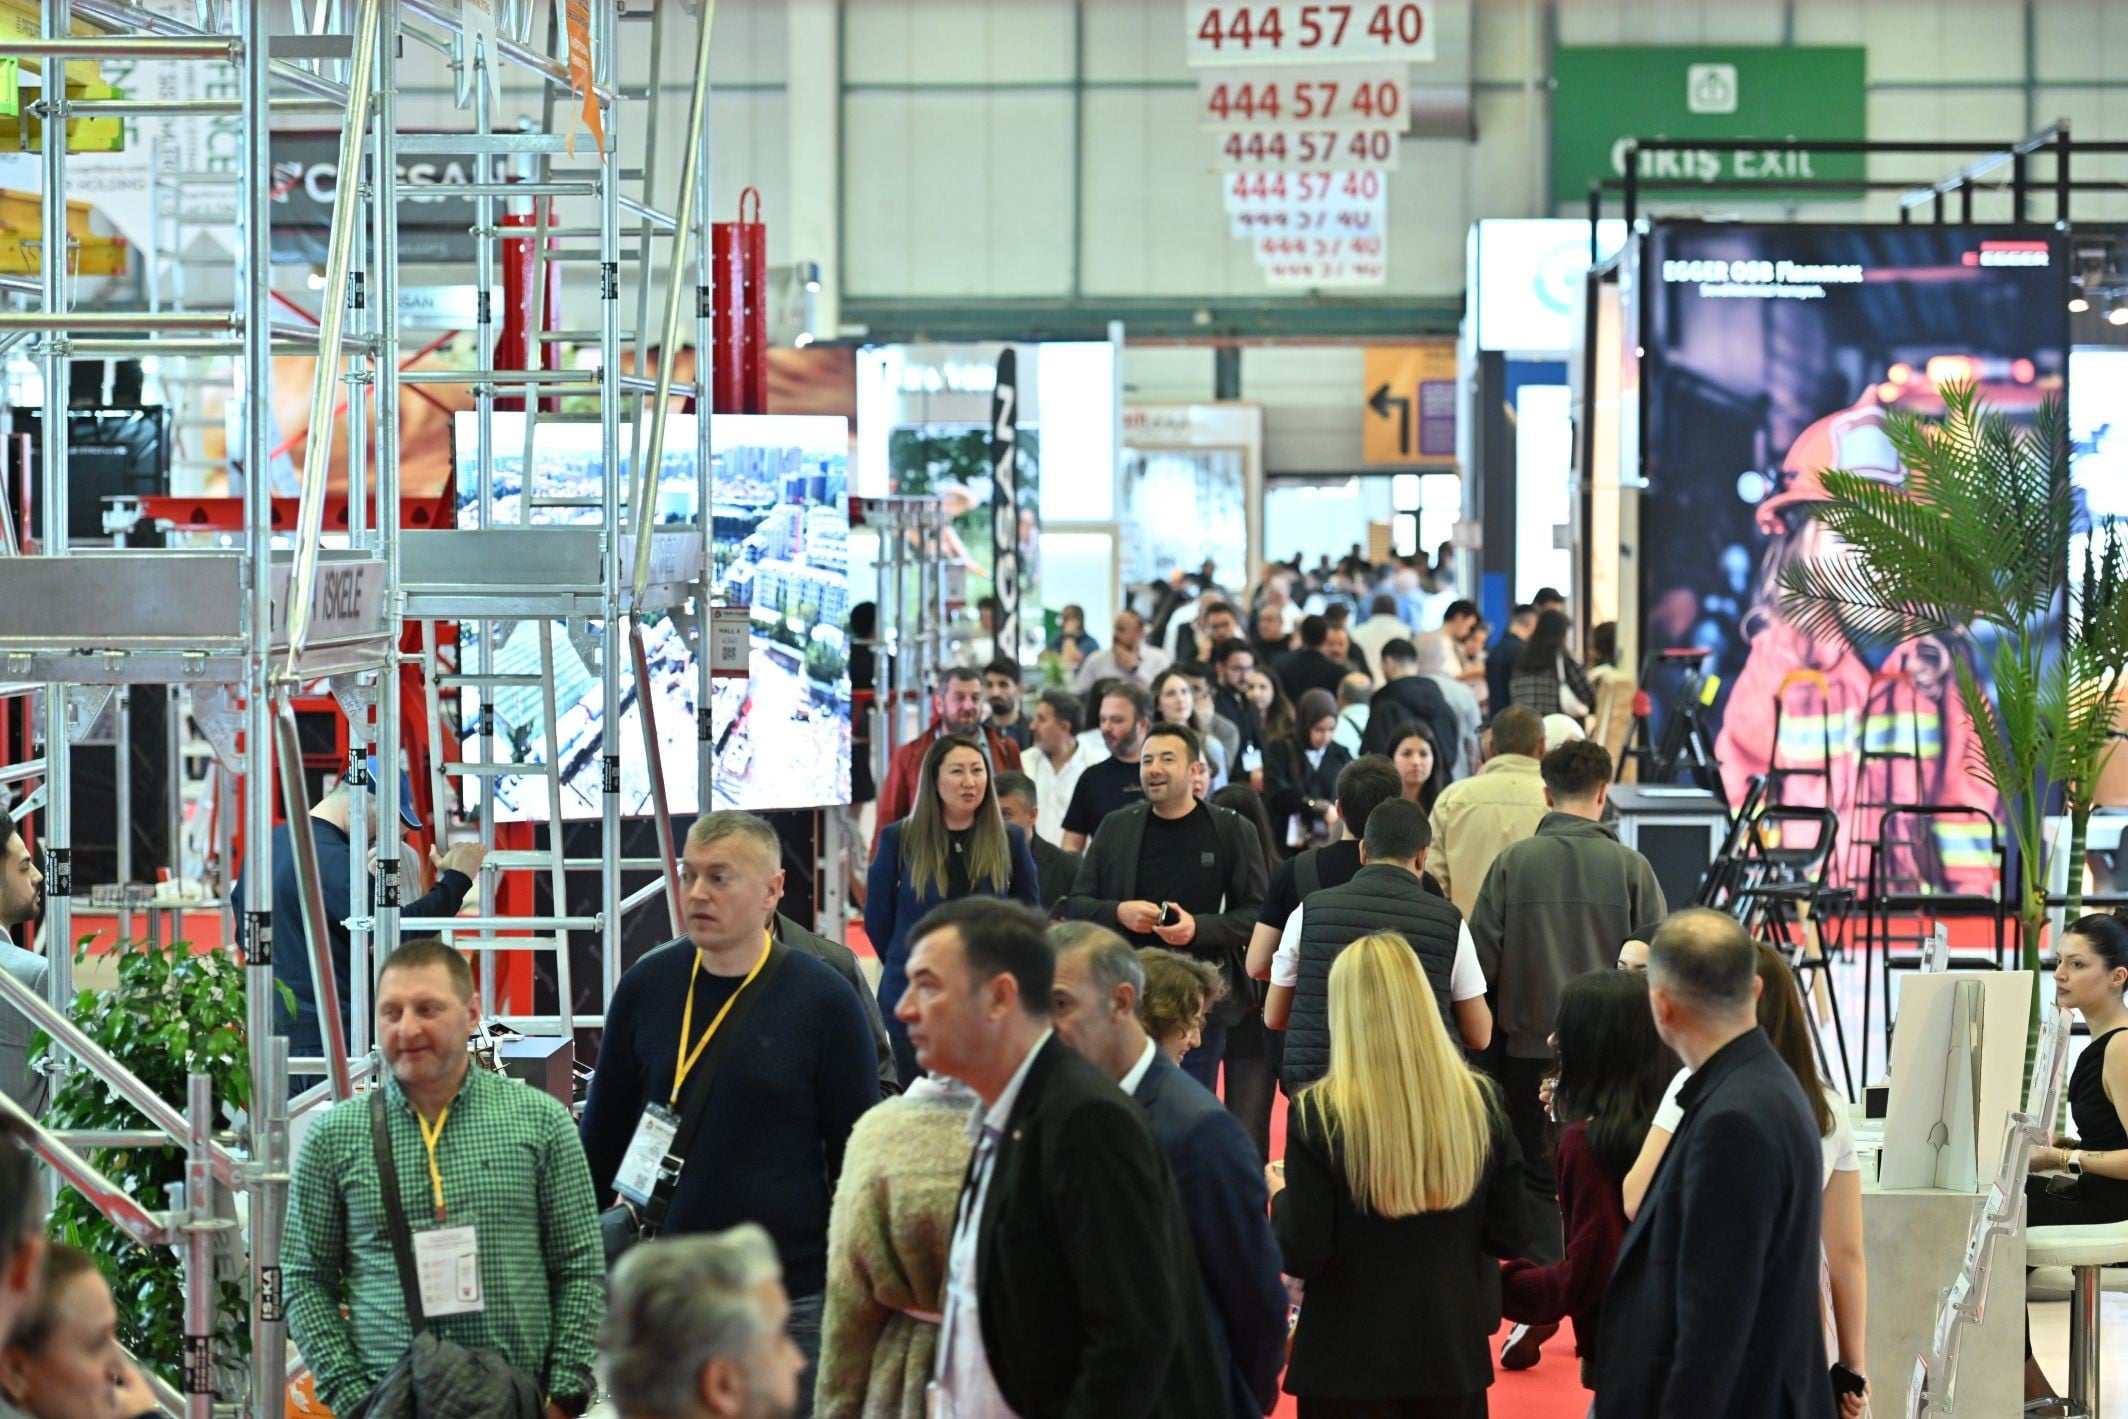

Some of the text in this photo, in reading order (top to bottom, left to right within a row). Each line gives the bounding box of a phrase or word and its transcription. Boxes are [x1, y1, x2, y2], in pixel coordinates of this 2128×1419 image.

[1197, 3, 1423, 49] 444 57 40
[1206, 81, 1400, 121] 444 57 40
[1223, 129, 1391, 163] 444 57 40
[1231, 170, 1379, 202] 444 57 40
[261, 1270, 273, 1320] IS-KA
